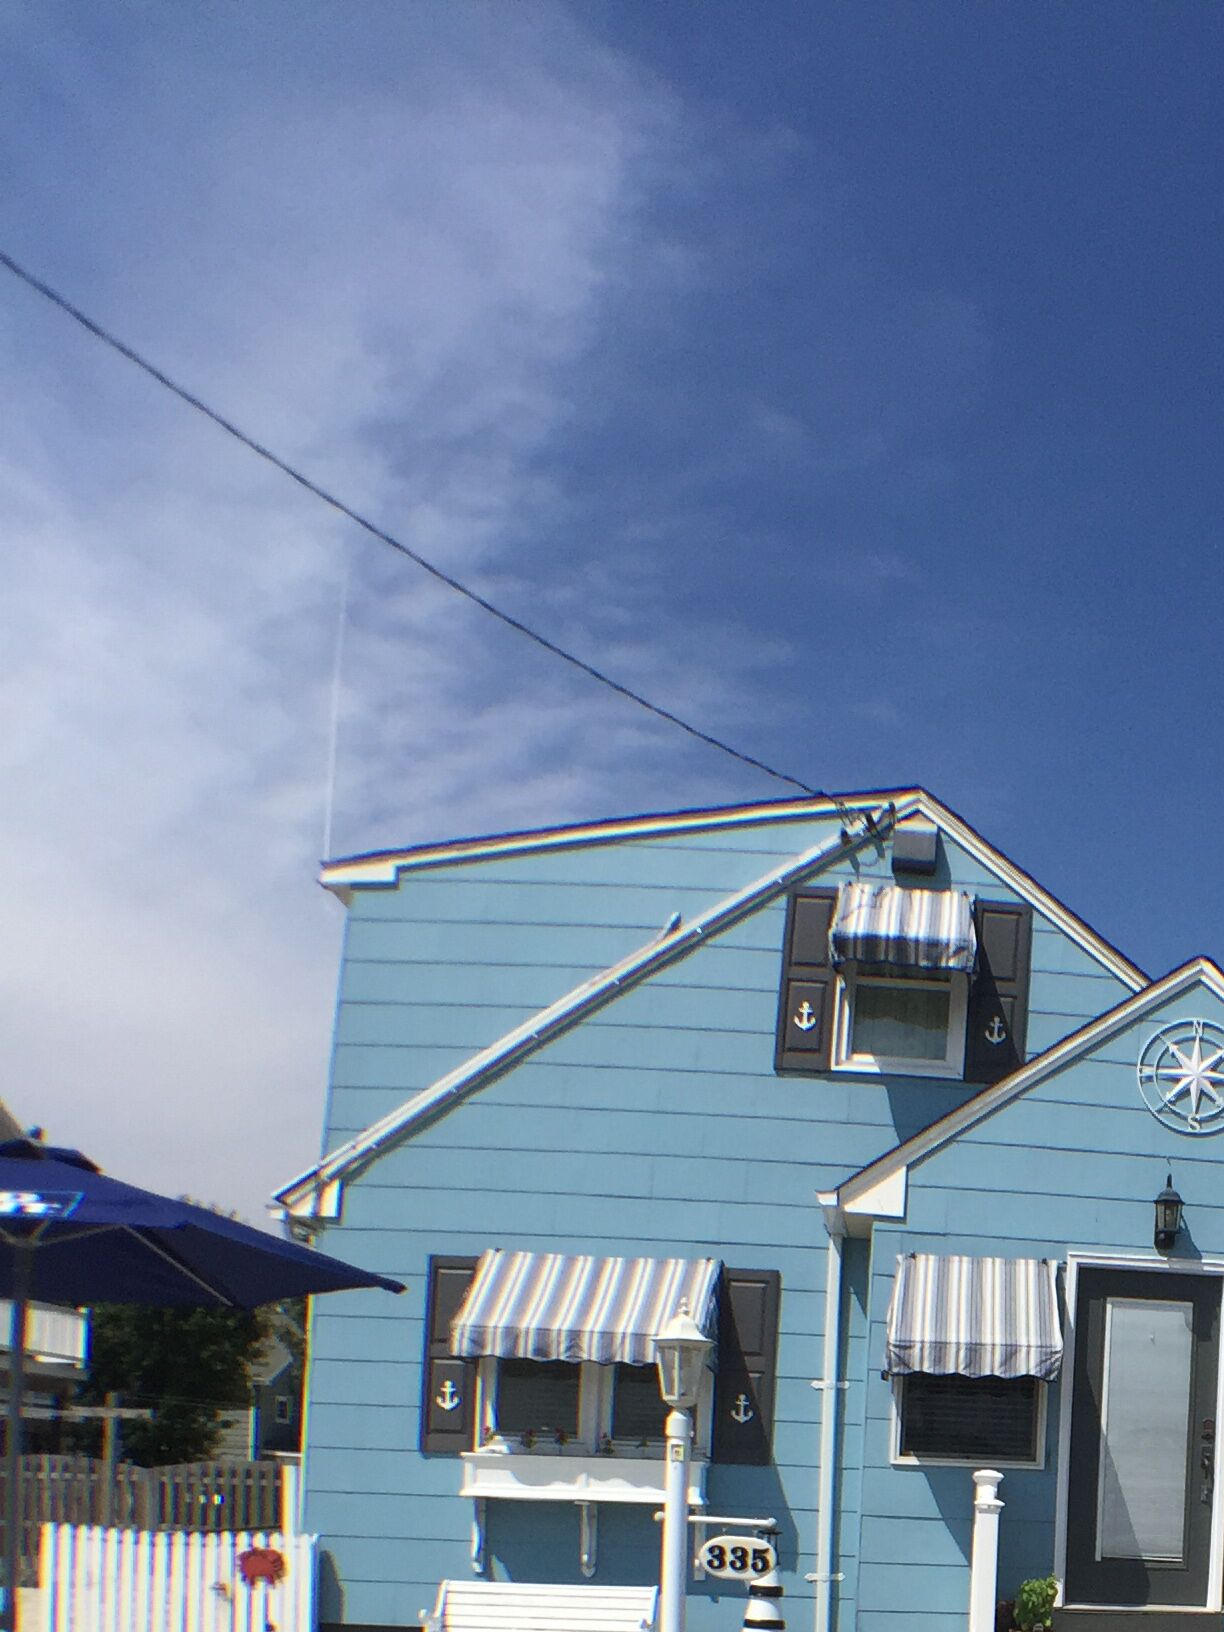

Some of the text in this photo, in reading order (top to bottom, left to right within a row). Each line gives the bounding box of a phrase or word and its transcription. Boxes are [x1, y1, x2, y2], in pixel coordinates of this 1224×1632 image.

[1192, 1018, 1204, 1037] N
[1187, 1113, 1201, 1132] S
[706, 1544, 770, 1573] 335
